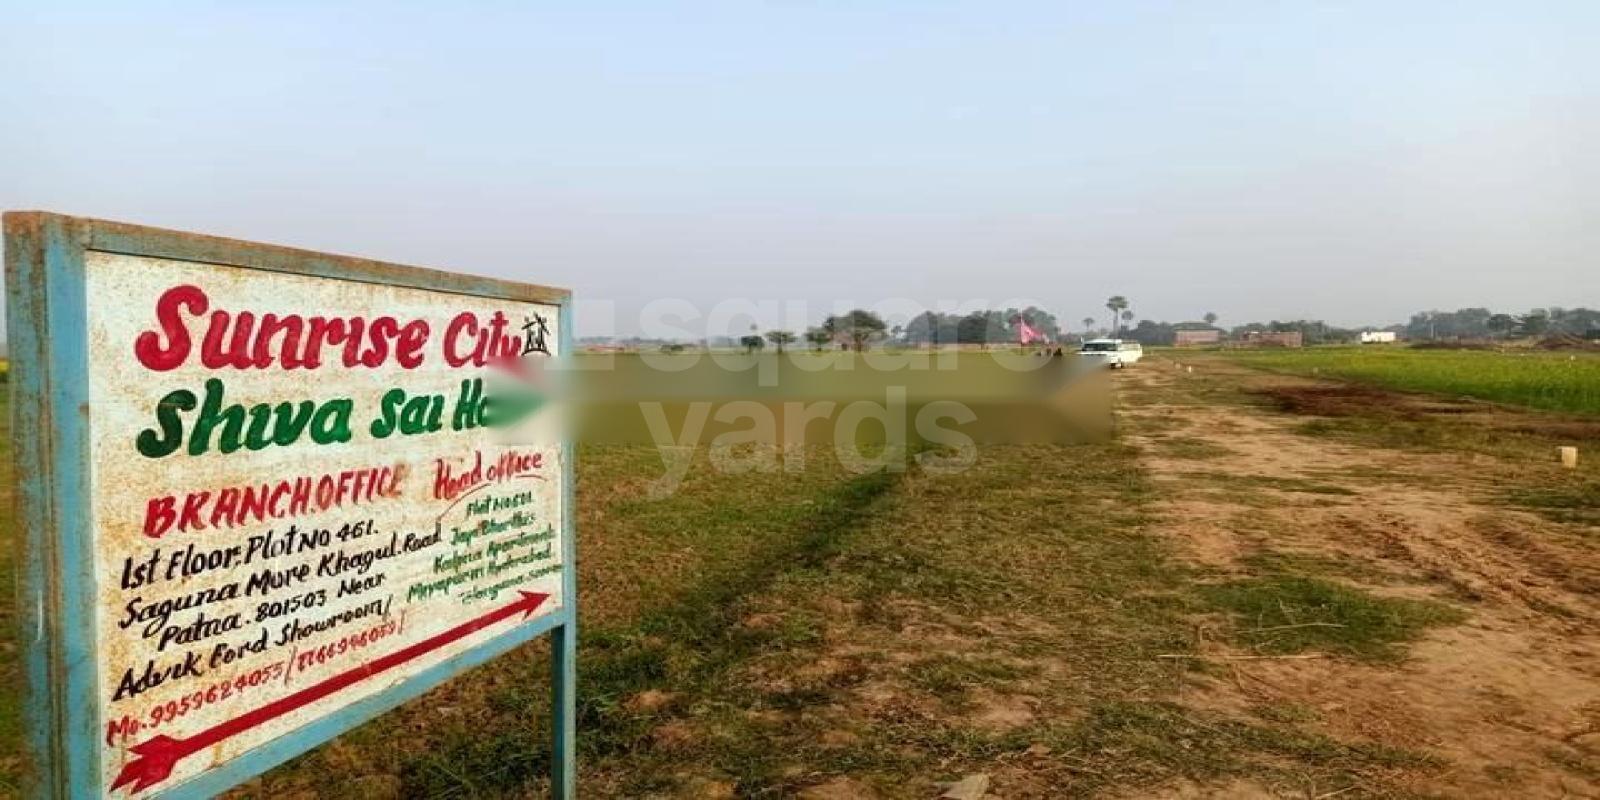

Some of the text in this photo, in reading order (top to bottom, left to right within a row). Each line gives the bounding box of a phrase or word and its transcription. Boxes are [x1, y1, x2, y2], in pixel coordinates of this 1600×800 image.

[135, 285, 522, 373] Sunrise City
[136, 377, 353, 458] Shiva
[370, 387, 445, 438] Sai
[433, 449, 543, 501] Head office
[118, 583, 241, 639] Saguna
[255, 588, 327, 622] 801503
[337, 572, 387, 598] Near
[208, 627, 268, 668] Ford
